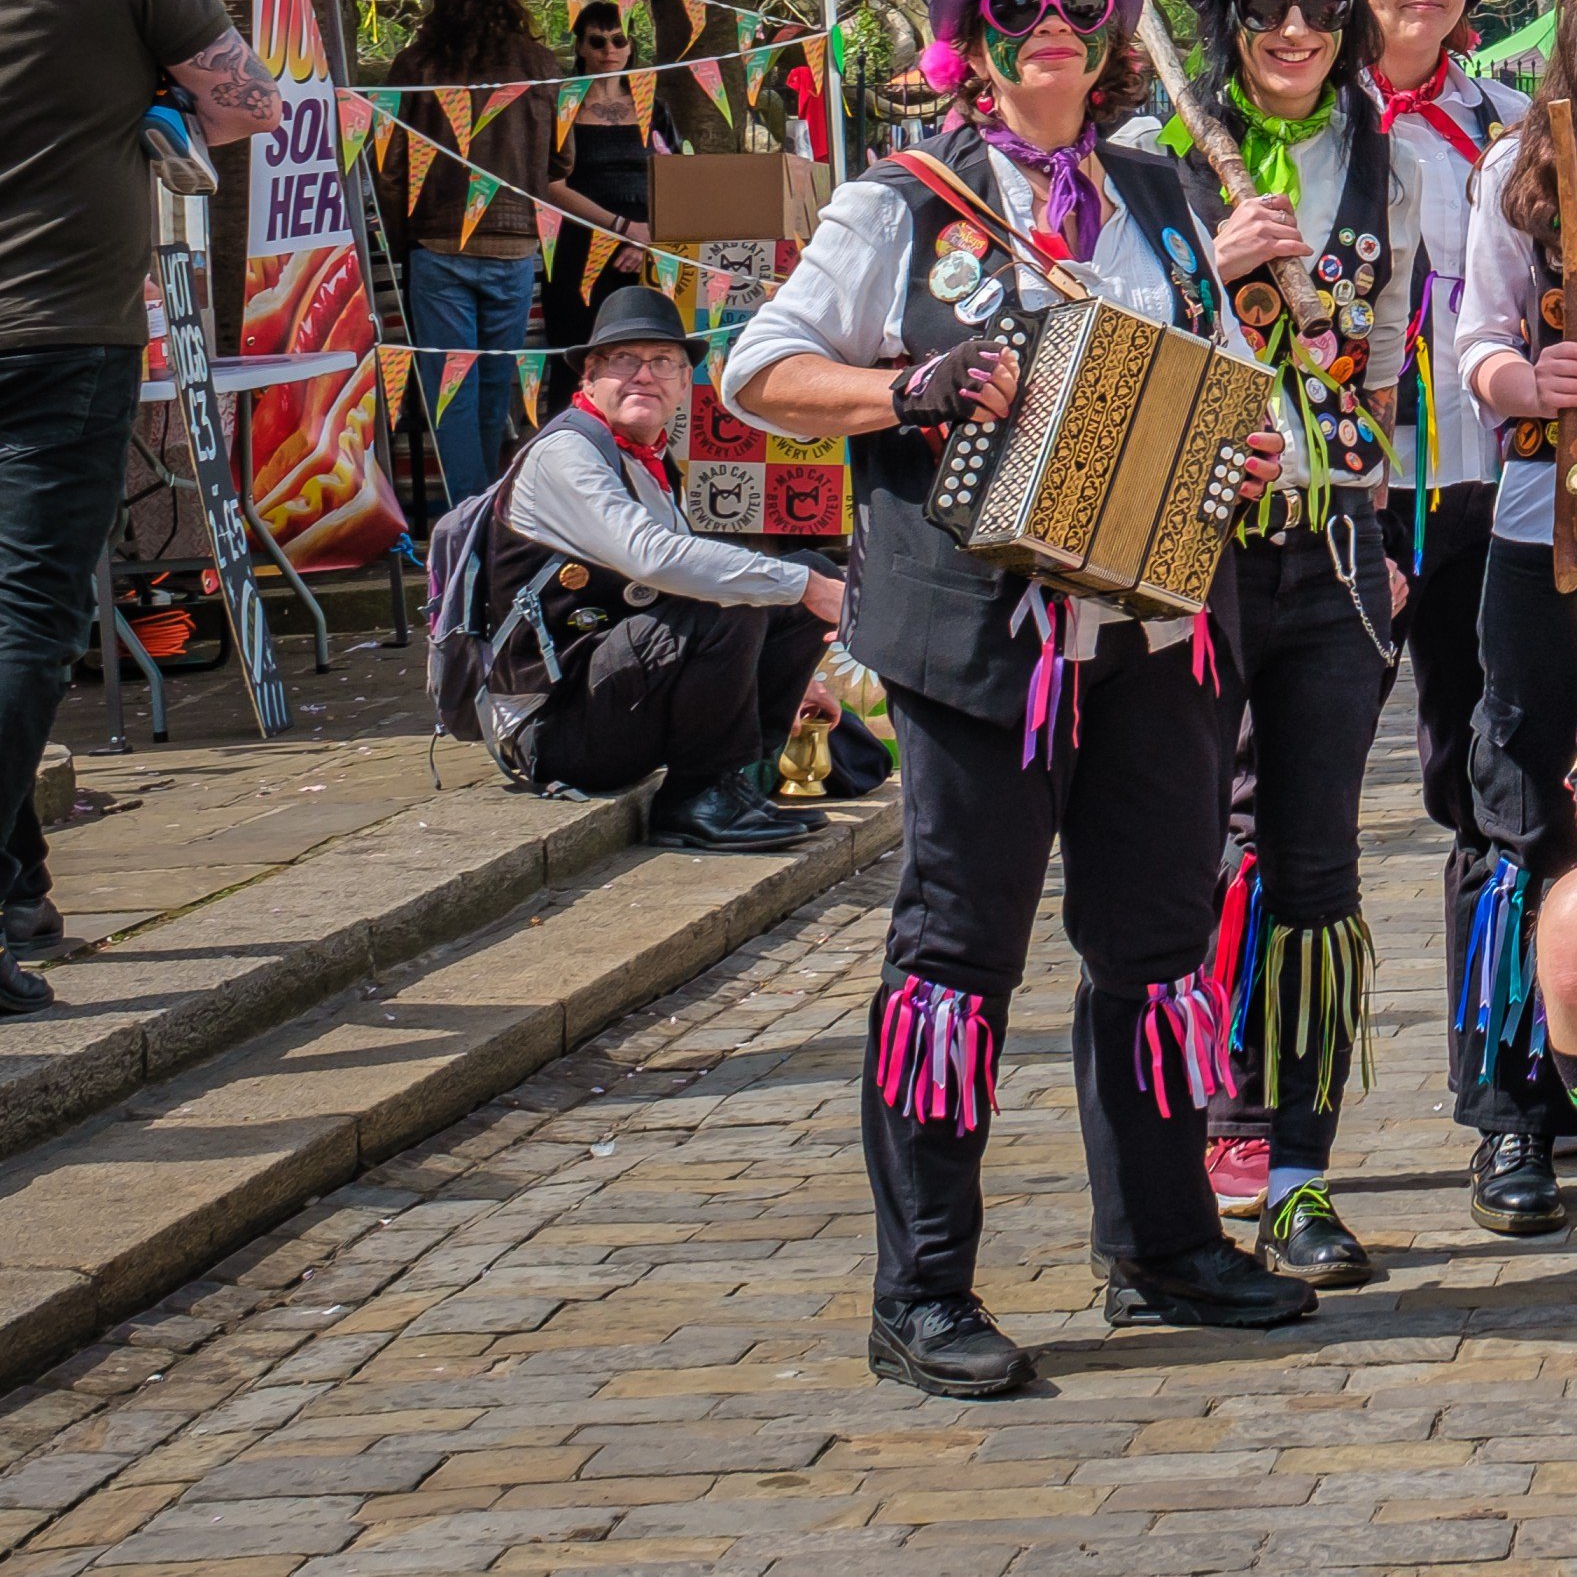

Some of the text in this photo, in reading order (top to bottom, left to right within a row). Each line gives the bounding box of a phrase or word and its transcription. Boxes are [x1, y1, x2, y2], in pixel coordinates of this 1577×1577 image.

[265, 98, 337, 168] SOL
[266, 170, 352, 242] HER
[160, 252, 192, 320] HOT
[171, 324, 208, 389] DOGS
[188, 387, 217, 463] £3
[1077, 401, 1106, 463] HOHNER
[699, 465, 754, 486] MAD CAT
[775, 467, 832, 487] MAD CAT
[690, 490, 761, 533] BREWERY LIMITED
[766, 493, 804, 534] BREWERY
[809, 494, 838, 534] LIMITED
